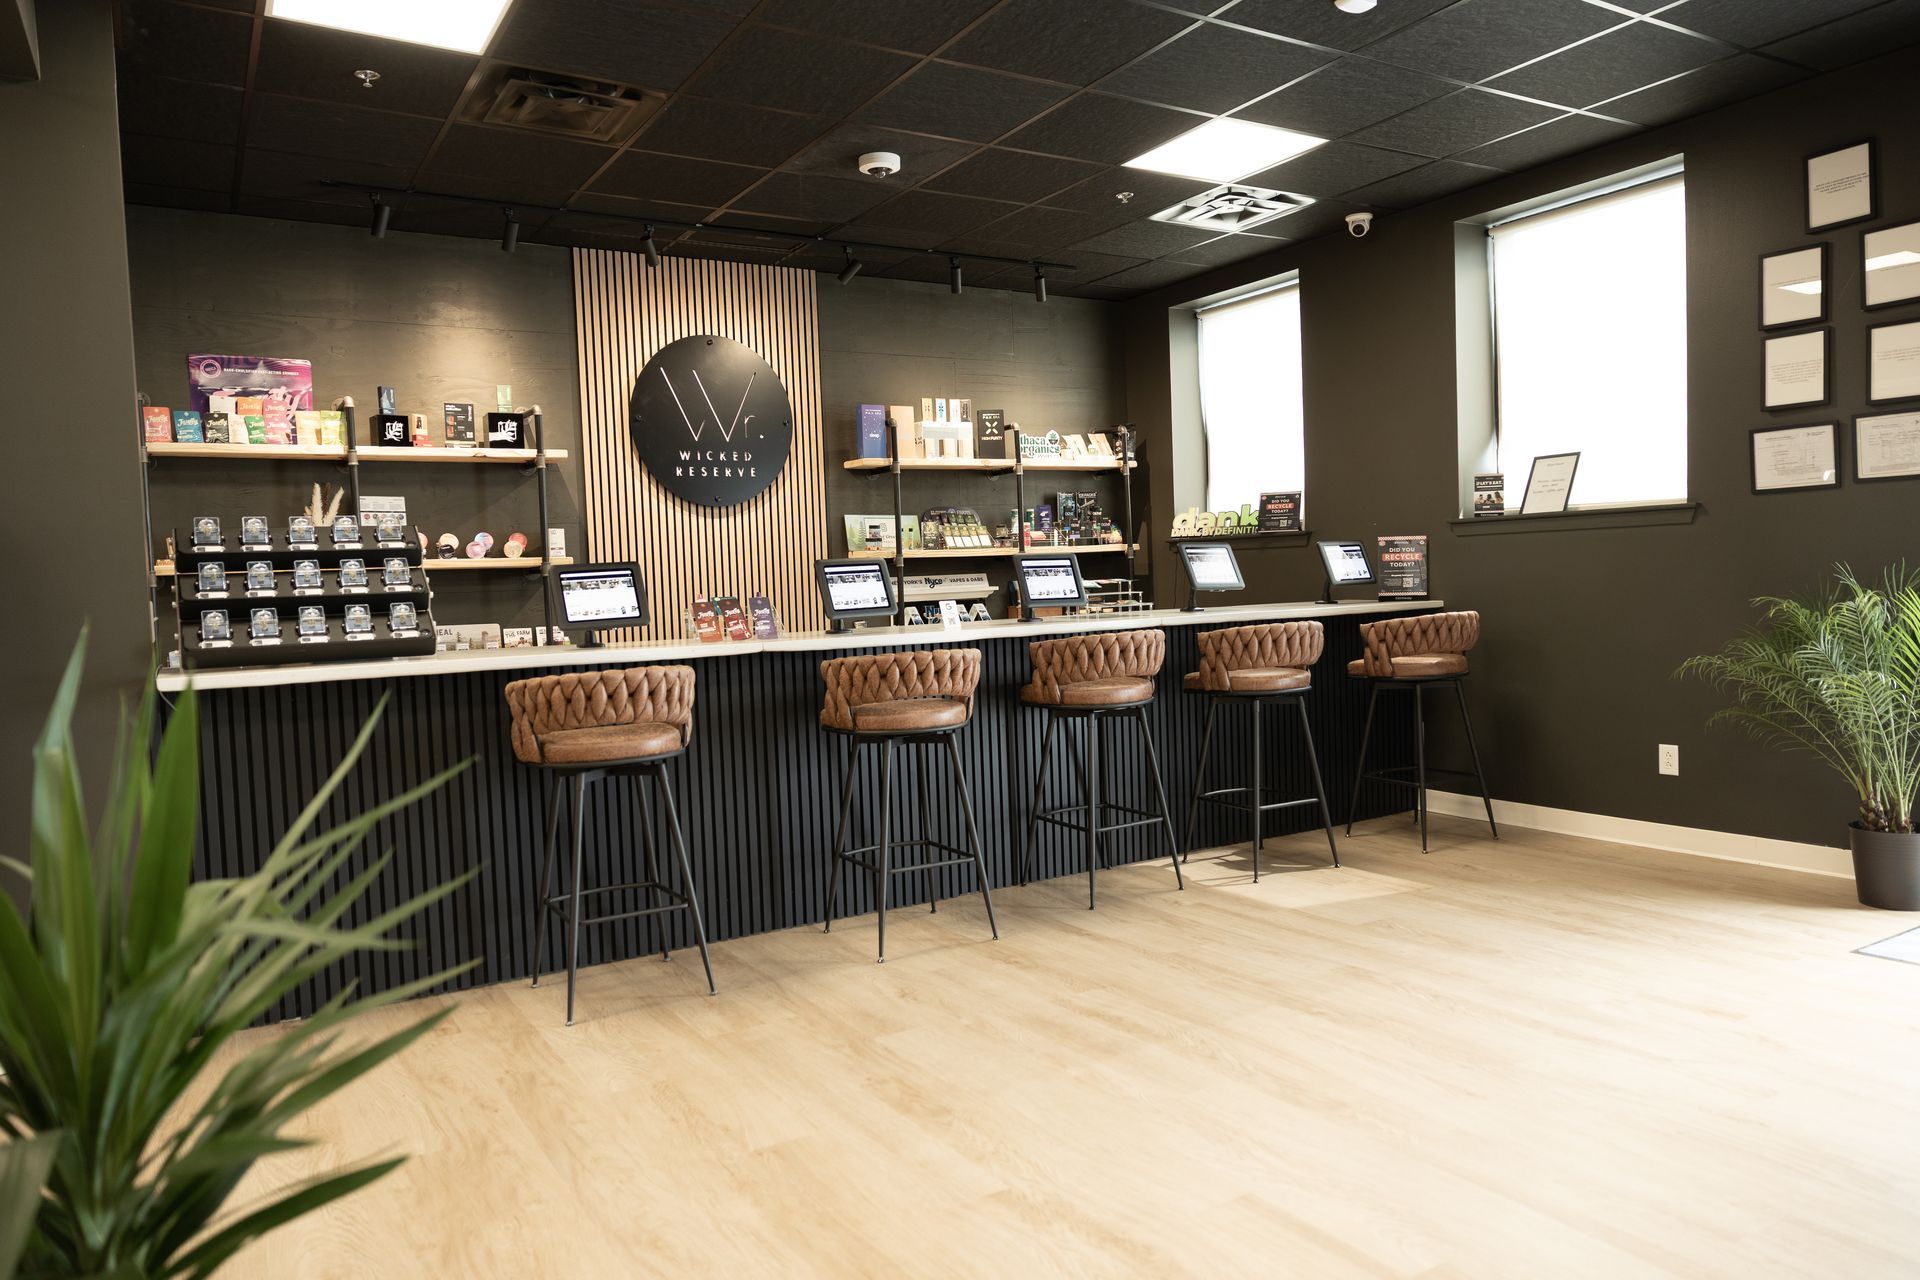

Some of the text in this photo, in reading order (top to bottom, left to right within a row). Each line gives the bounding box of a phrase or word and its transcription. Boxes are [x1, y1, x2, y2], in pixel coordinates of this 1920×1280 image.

[679, 450, 752, 461] WICKED
[676, 466, 757, 478] RESERVE
[1172, 504, 1259, 527] dank
[924, 577, 943, 588] Nyce
